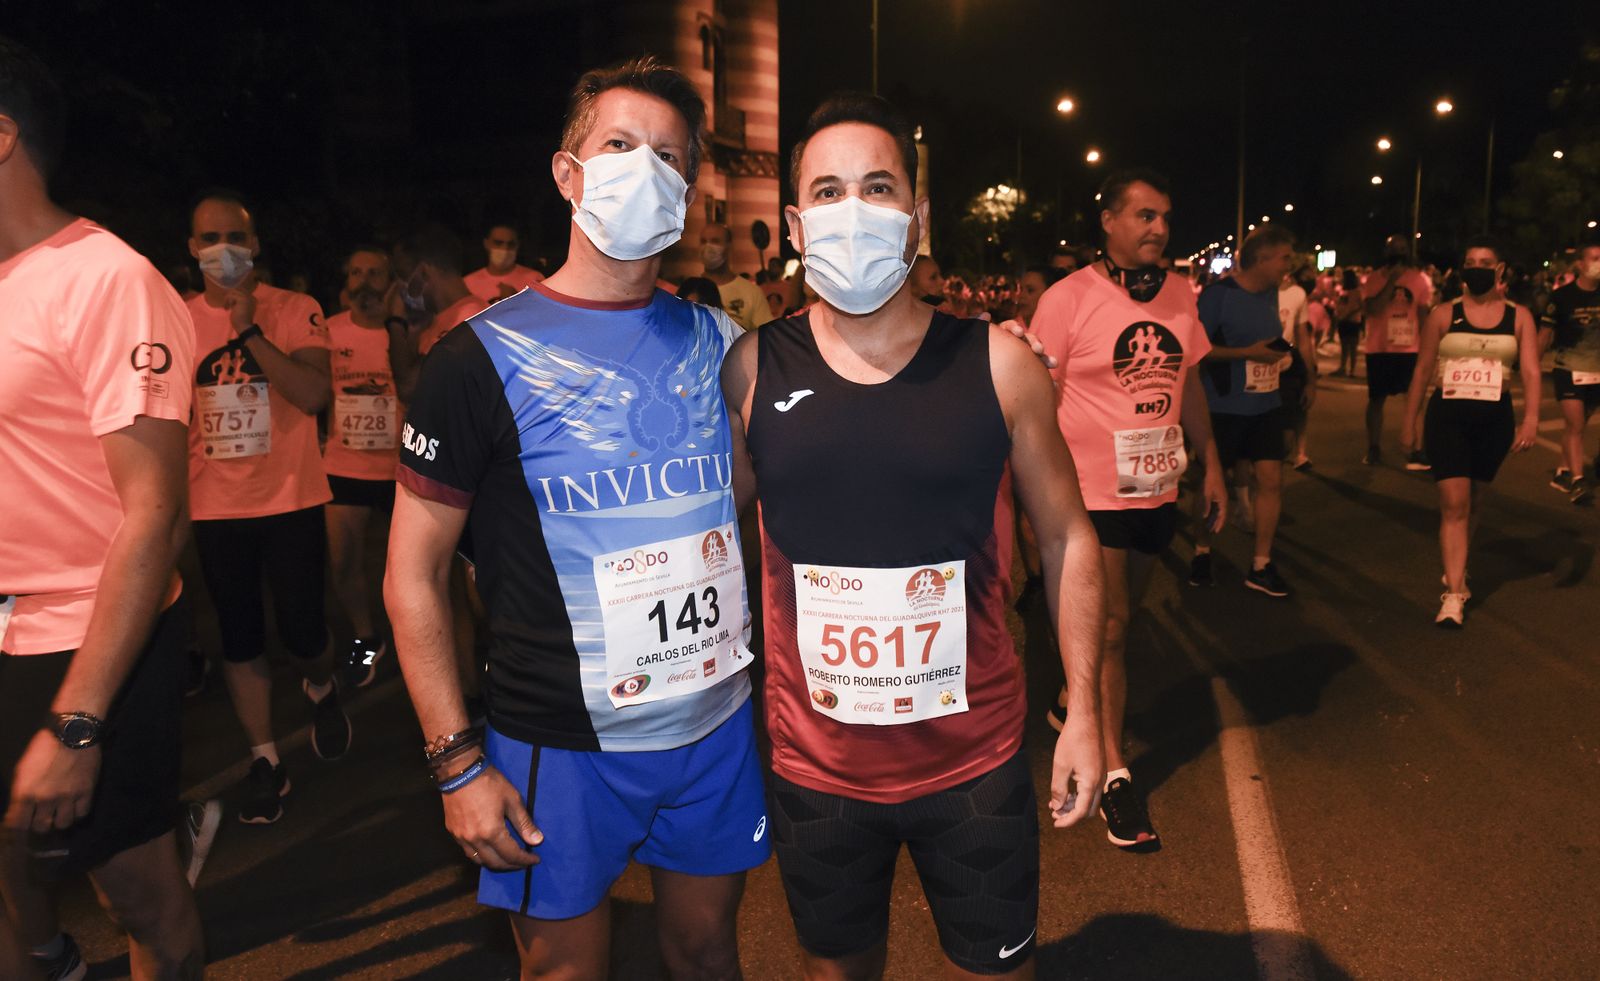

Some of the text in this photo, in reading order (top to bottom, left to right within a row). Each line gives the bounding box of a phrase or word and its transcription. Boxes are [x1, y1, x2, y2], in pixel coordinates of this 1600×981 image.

[1120, 370, 1177, 387] LA NOCTURNA
[1452, 370, 1492, 383] 6701
[203, 409, 257, 433] 5757
[342, 415, 387, 431] 4728
[1128, 450, 1179, 476] 7886
[626, 591, 653, 603] CARRERA
[654, 583, 685, 596] NOCTURNA
[686, 580, 696, 589] DEL
[648, 586, 721, 643] 143
[818, 611, 843, 620] CARRERA
[844, 613, 878, 622] NOCTURNA
[892, 610, 937, 622] GUADALQUIVIR
[951, 605, 965, 613] 2021
[636, 647, 680, 667] CARLOS
[682, 643, 698, 657] DEL
[701, 636, 714, 651] RIO
[715, 629, 730, 645] LIMA
[821, 621, 941, 669] 5617
[808, 667, 851, 686] ROBERTO
[853, 676, 901, 687] ROMERO
[904, 665, 961, 686] GUTIÉRREZ
